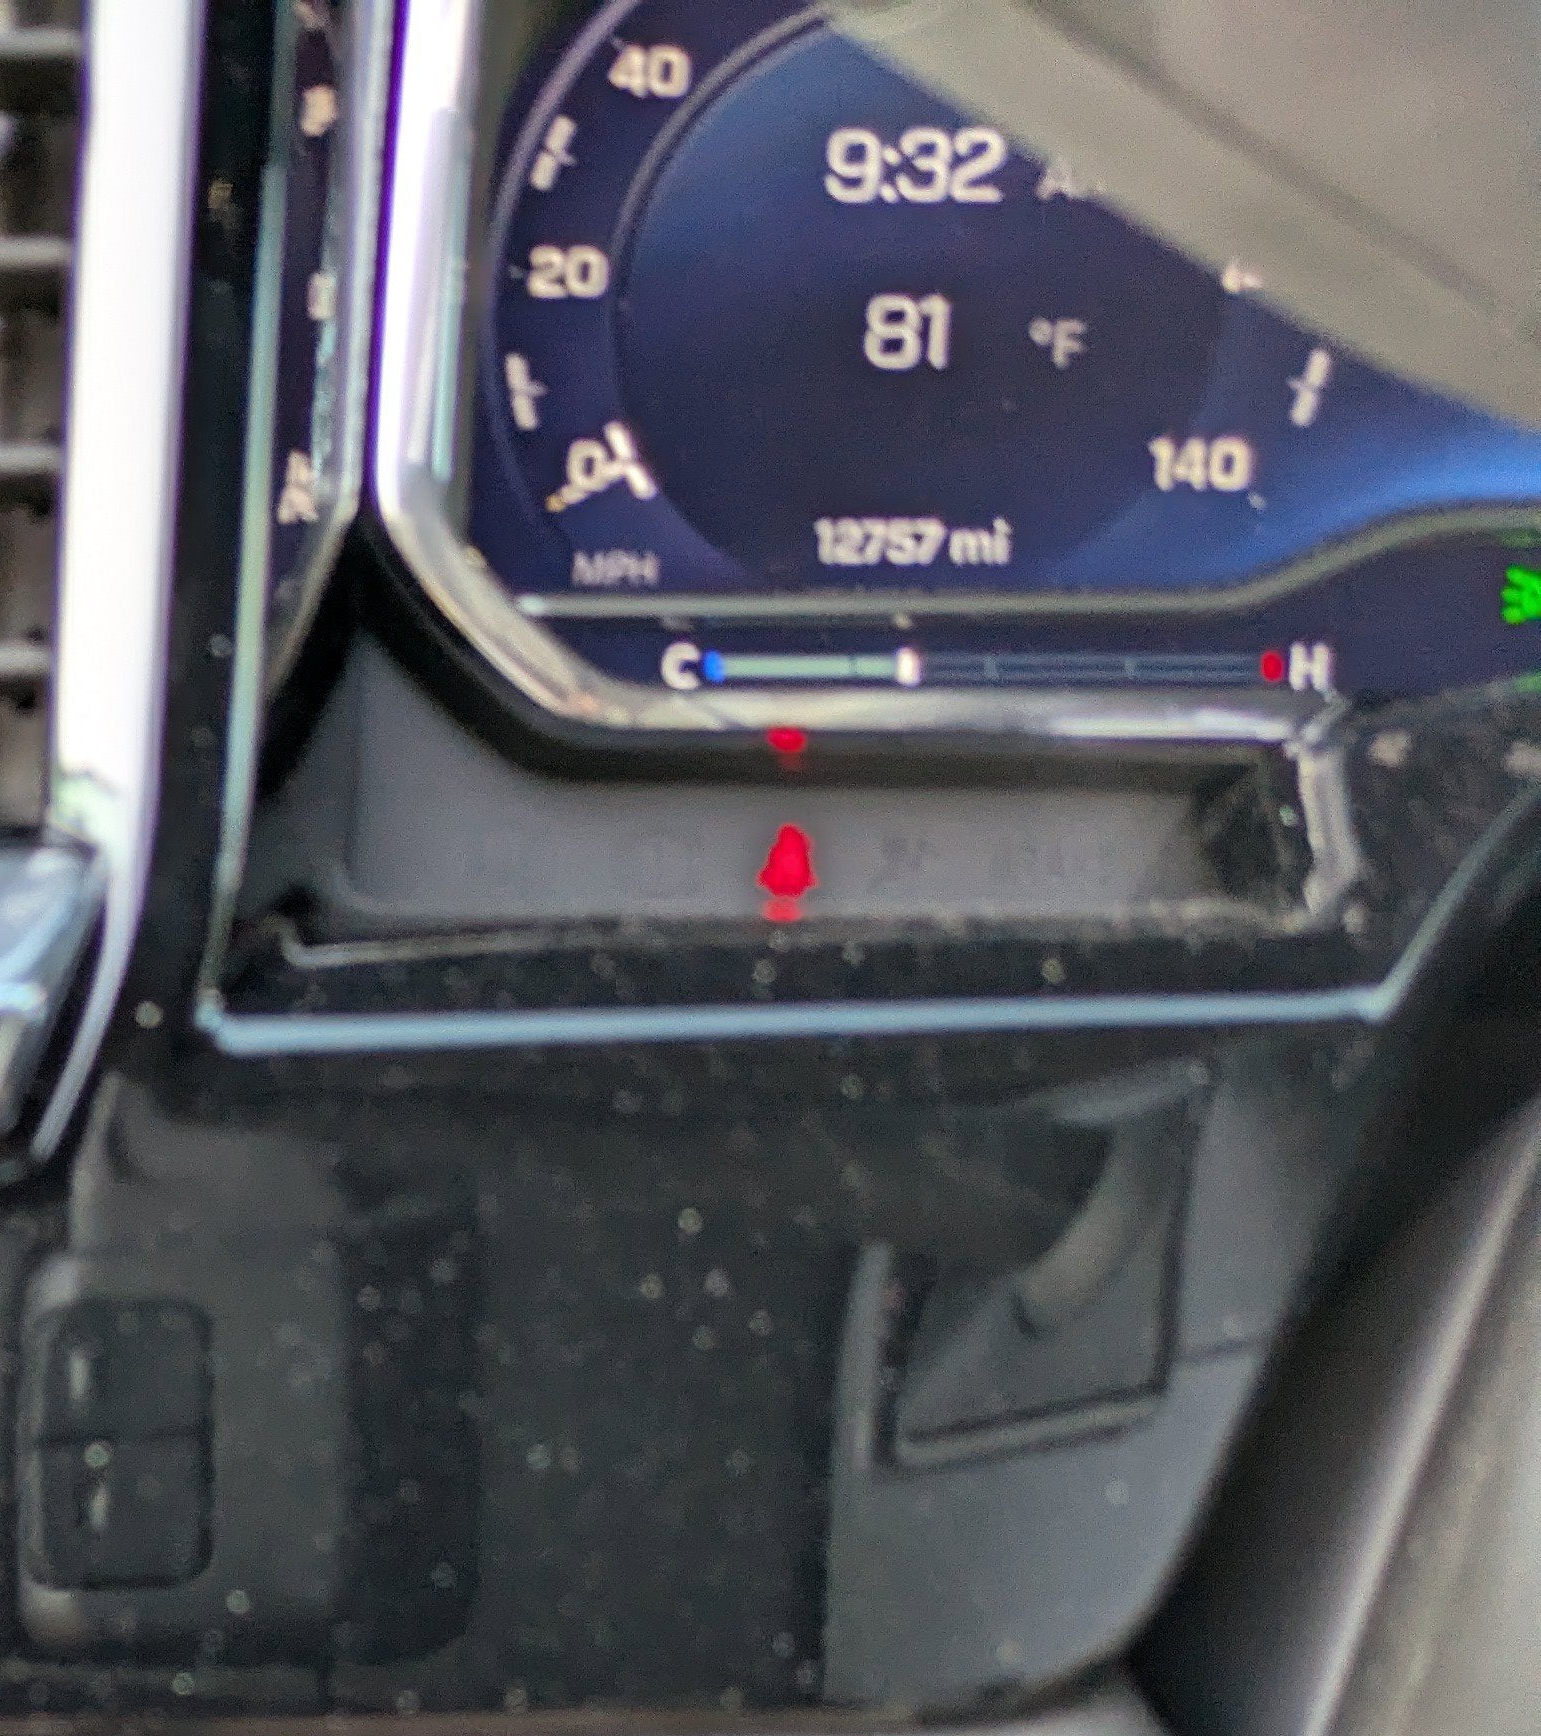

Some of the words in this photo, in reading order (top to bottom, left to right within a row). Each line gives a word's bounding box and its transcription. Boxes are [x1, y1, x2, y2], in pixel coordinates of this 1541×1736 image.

[607, 43, 692, 98] 40
[824, 125, 1008, 204] 9:32
[526, 244, 610, 300] 20
[864, 292, 952, 370] 81
[1147, 435, 1253, 492] 140
[571, 548, 660, 588] MPH
[816, 517, 946, 566] 12757
[948, 516, 1013, 567] mi
[660, 642, 701, 692] C
[1289, 644, 1332, 691] H
